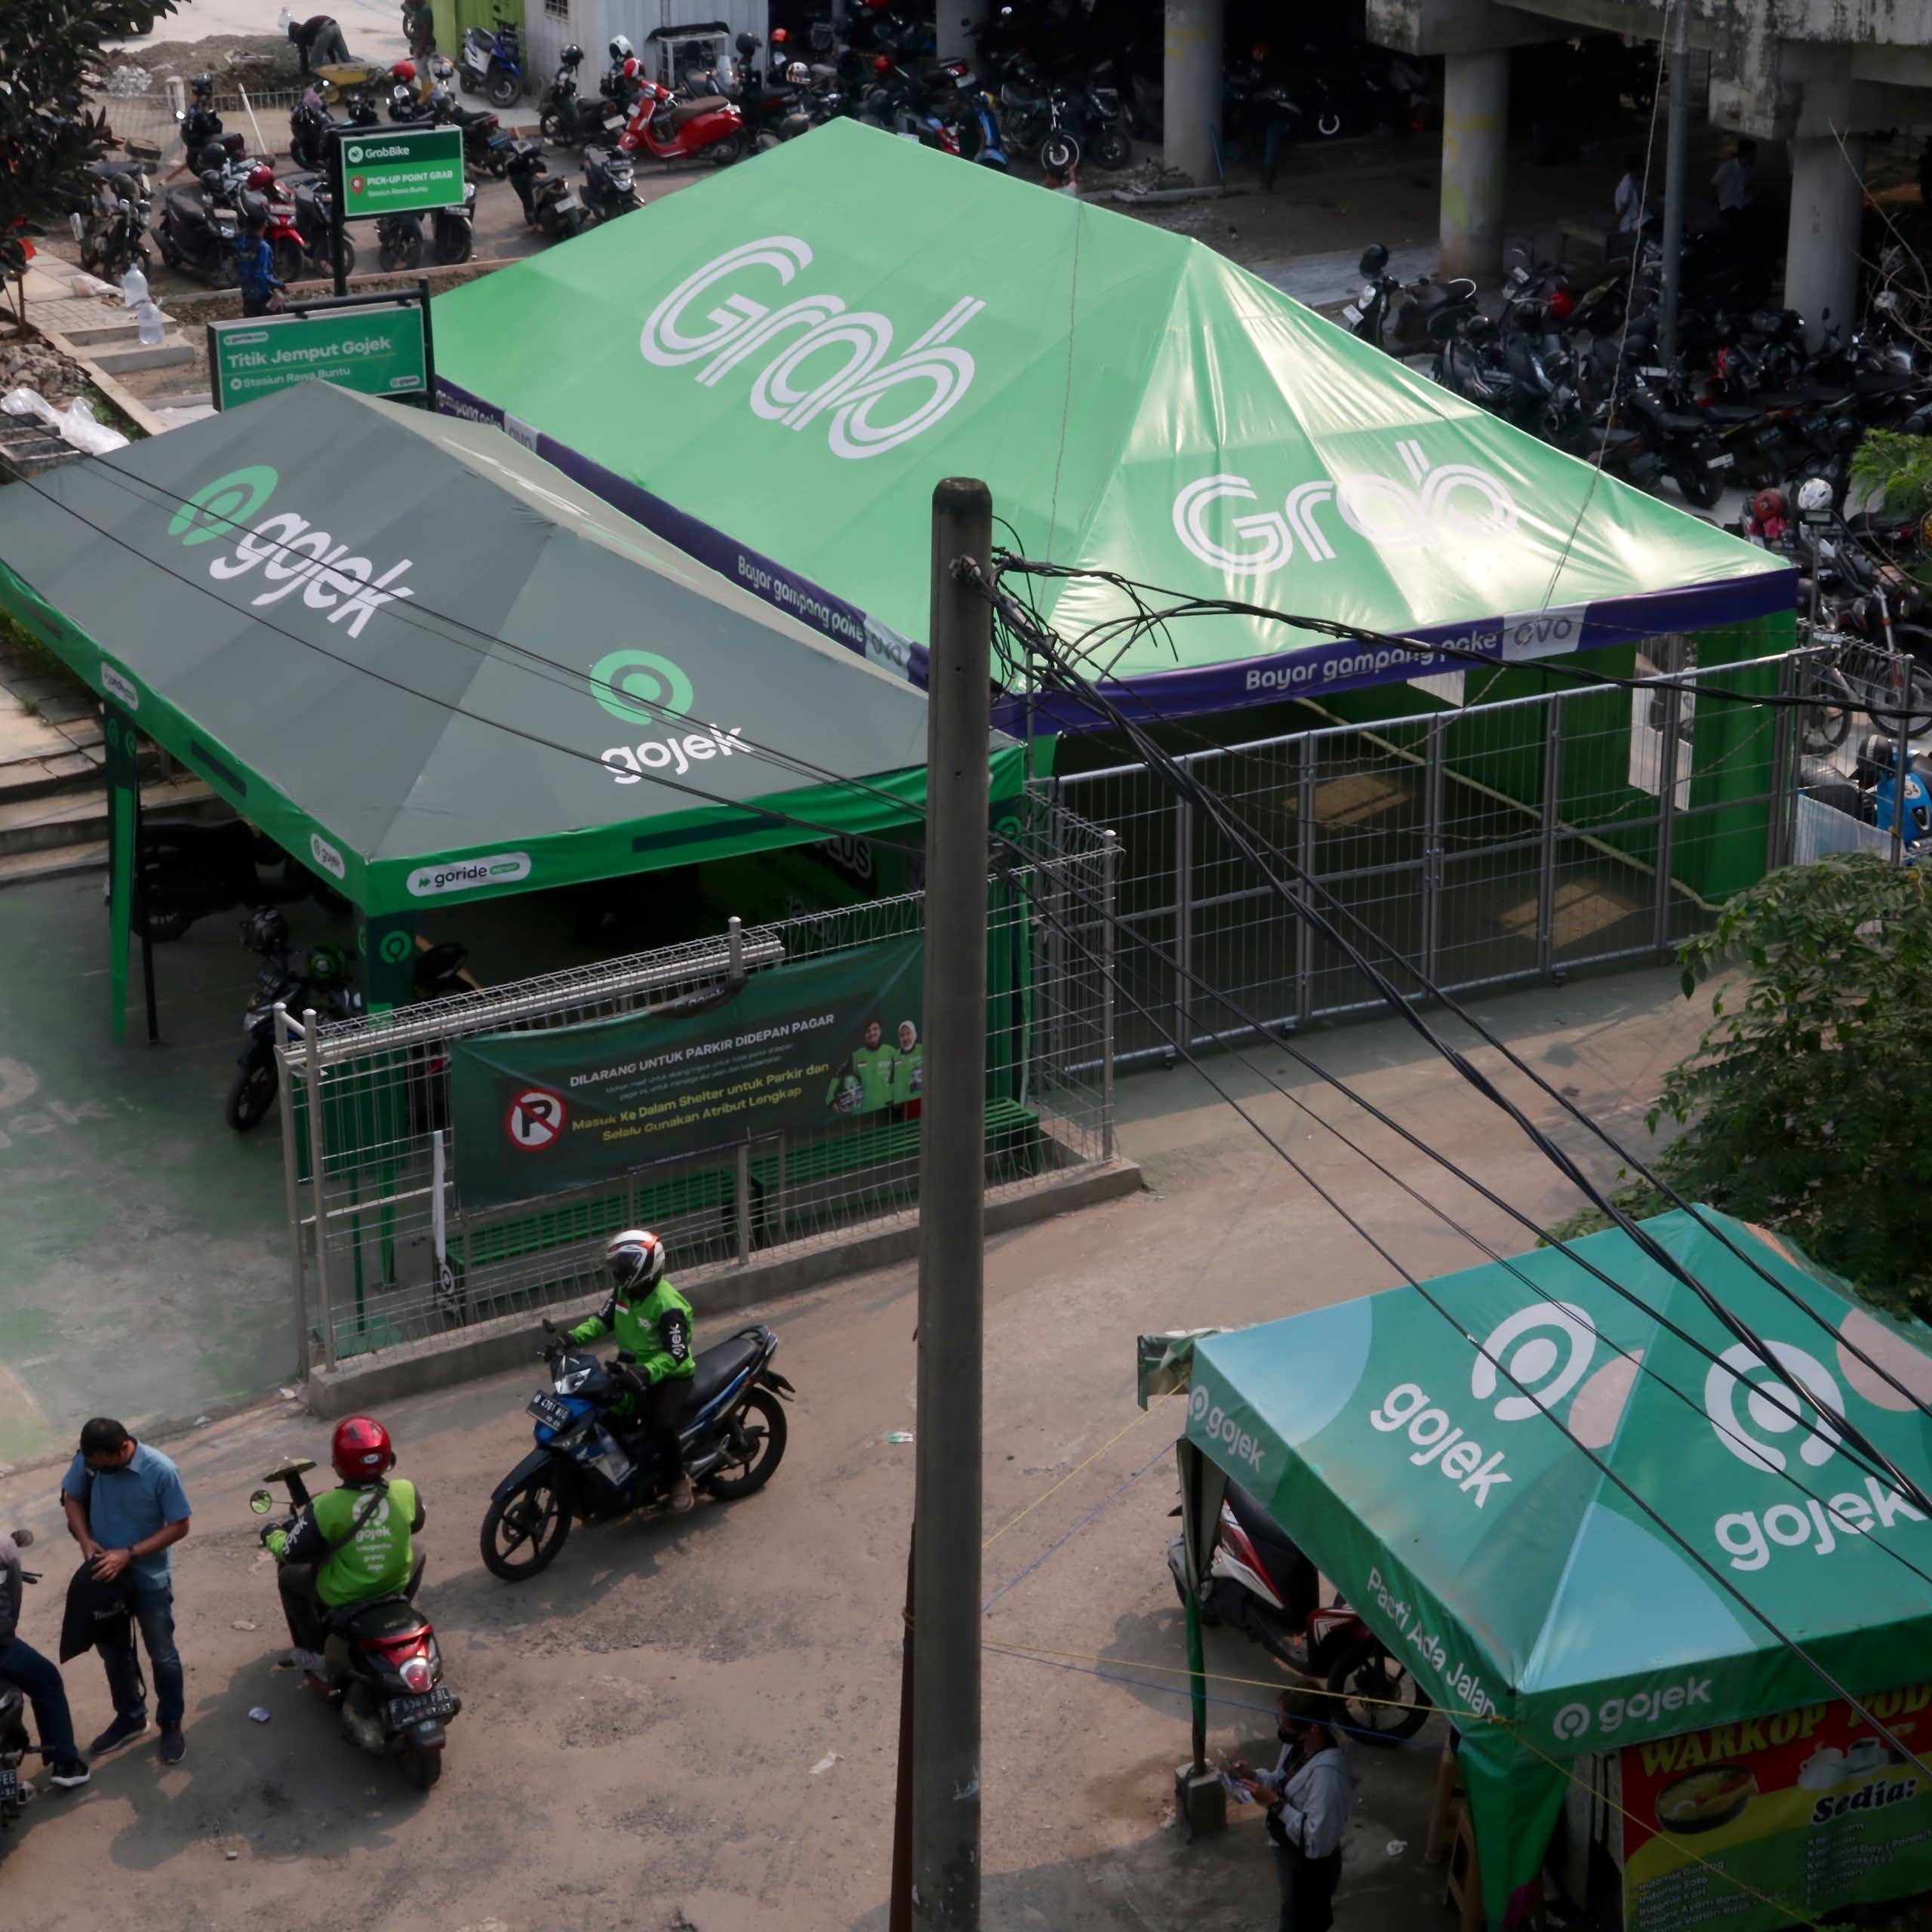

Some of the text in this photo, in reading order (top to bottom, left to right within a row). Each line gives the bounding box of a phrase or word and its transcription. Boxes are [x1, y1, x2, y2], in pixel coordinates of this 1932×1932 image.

[365, 146, 410, 158] GrabBike
[367, 170, 454, 186] PICK-UP POINT GRAB
[228, 337, 392, 368] Titik Jemput Gojek
[640, 235, 986, 459] Grab
[244, 374, 285, 388] Stasiun
[318, 367, 351, 378] Buntu
[1172, 439, 1518, 576] Grab
[209, 512, 414, 639] gojek
[737, 554, 863, 643] Bayar gampang pake
[1513, 617, 1574, 647] OVO
[1246, 663, 1318, 691] Bayar
[1323, 645, 1435, 681] gampang
[601, 723, 755, 785] gojek
[434, 865, 488, 888] goride
[570, 1014, 835, 1088] DILARANG UNTUK PARKIR DIDEPAN PAGAR
[571, 1062, 829, 1131] Masuk Ke Dalam Shelter untuk Parkir dan
[602, 1085, 803, 1141] Selalu Gunakan Atribut Lengkap
[1205, 1405, 1267, 1474] gojek
[1370, 1382, 1513, 1509] gojek
[281, 1515, 308, 1555] gojek
[355, 1525, 391, 1543] gojek
[1714, 1475, 1930, 1572] gojek
[1367, 1565, 1497, 1725] Pasti Ada Jalan
[1597, 1675, 1714, 1732] gojek
[1638, 1703, 1829, 1778] WARKOP
[1810, 1778, 1918, 1825] Sedia:
